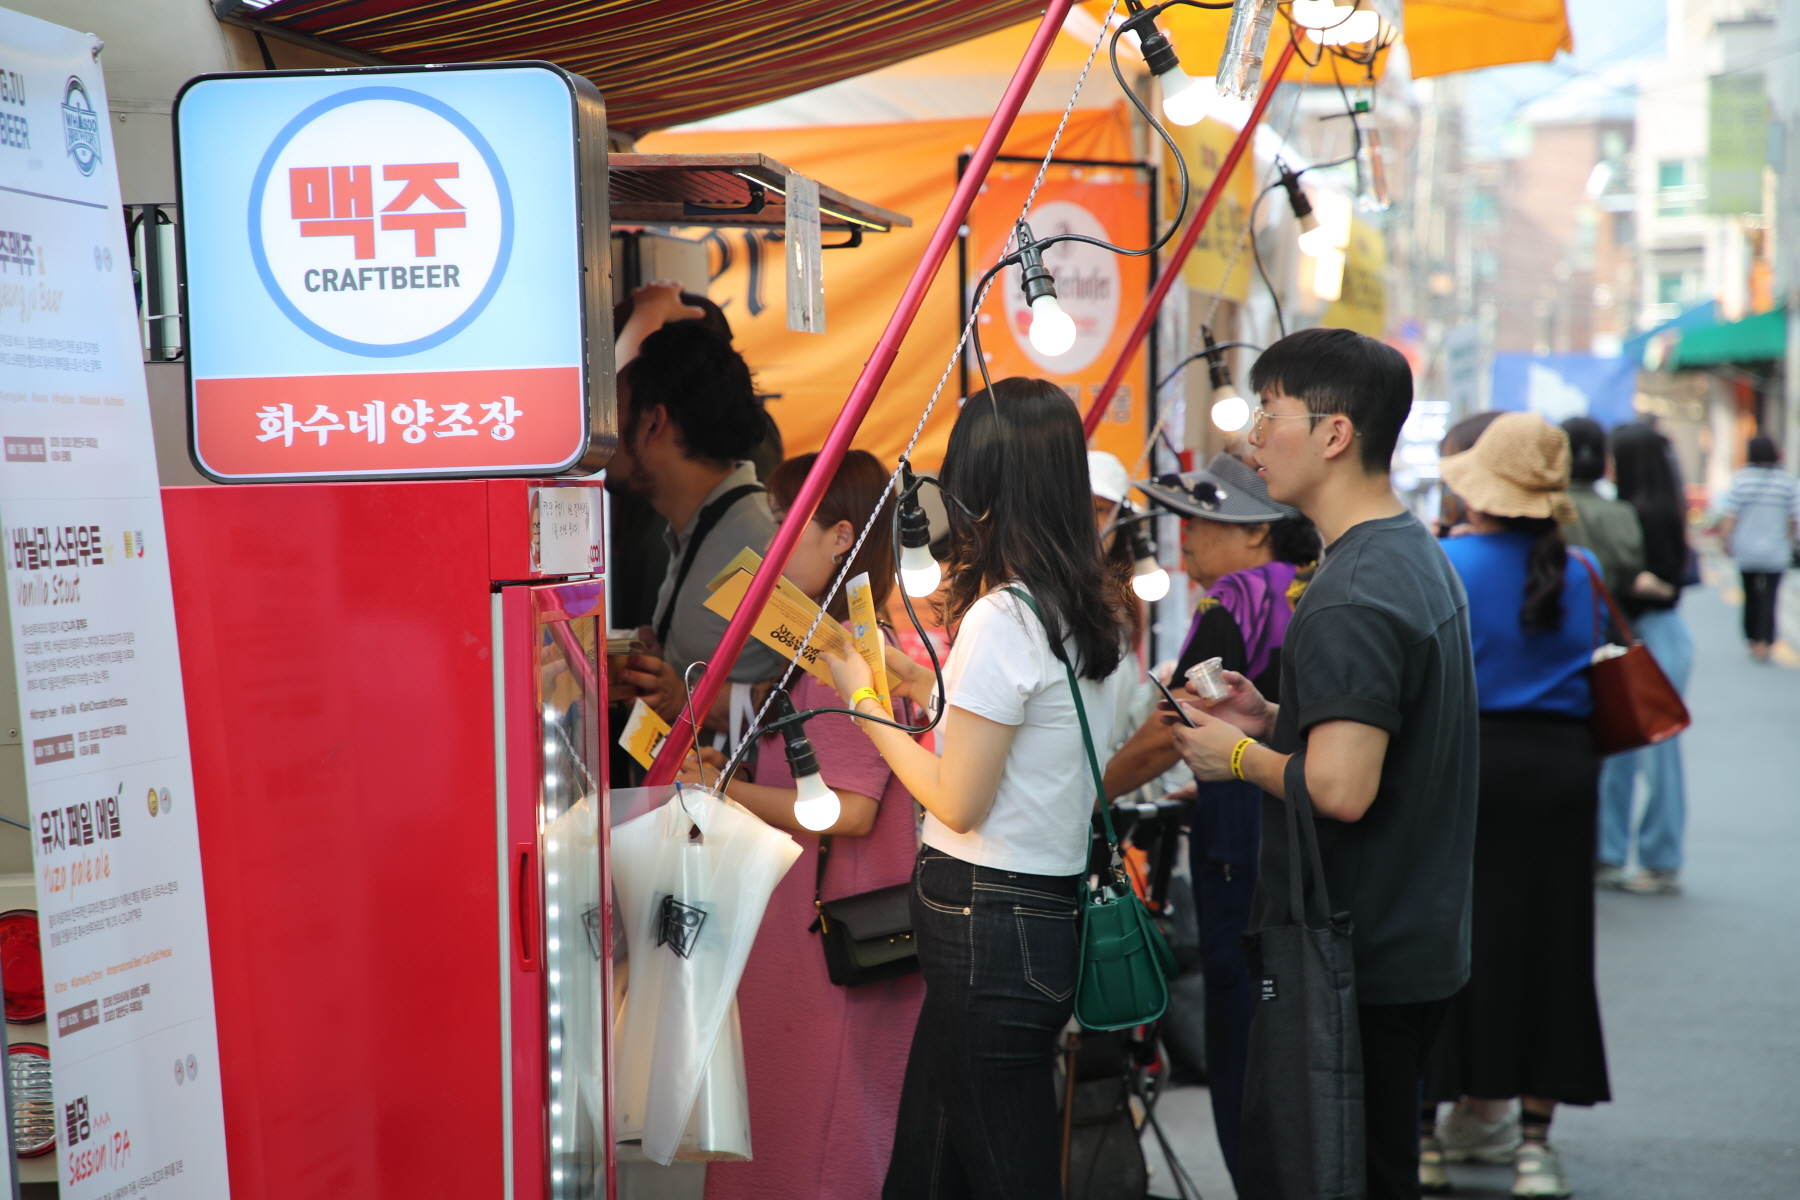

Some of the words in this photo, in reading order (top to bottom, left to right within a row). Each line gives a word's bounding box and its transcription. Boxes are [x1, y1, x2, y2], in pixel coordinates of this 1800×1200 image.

[288, 161, 468, 260] 맥주
[304, 264, 461, 292] CRAFTBEER
[255, 395, 523, 448] 화수네양조장
[12, 526, 52, 571] 바닐라
[54, 525, 104, 567] 스타우트
[16, 573, 49, 607] Vanilla
[52, 573, 81, 606] Stout
[41, 808, 66, 855] 유자
[66, 801, 94, 847] 페일
[95, 796, 122, 840] 에일
[95, 848, 111, 881] ale
[65, 1094, 90, 1147] 불멍
[69, 1140, 107, 1186] Session
[109, 1129, 132, 1172] IPA
